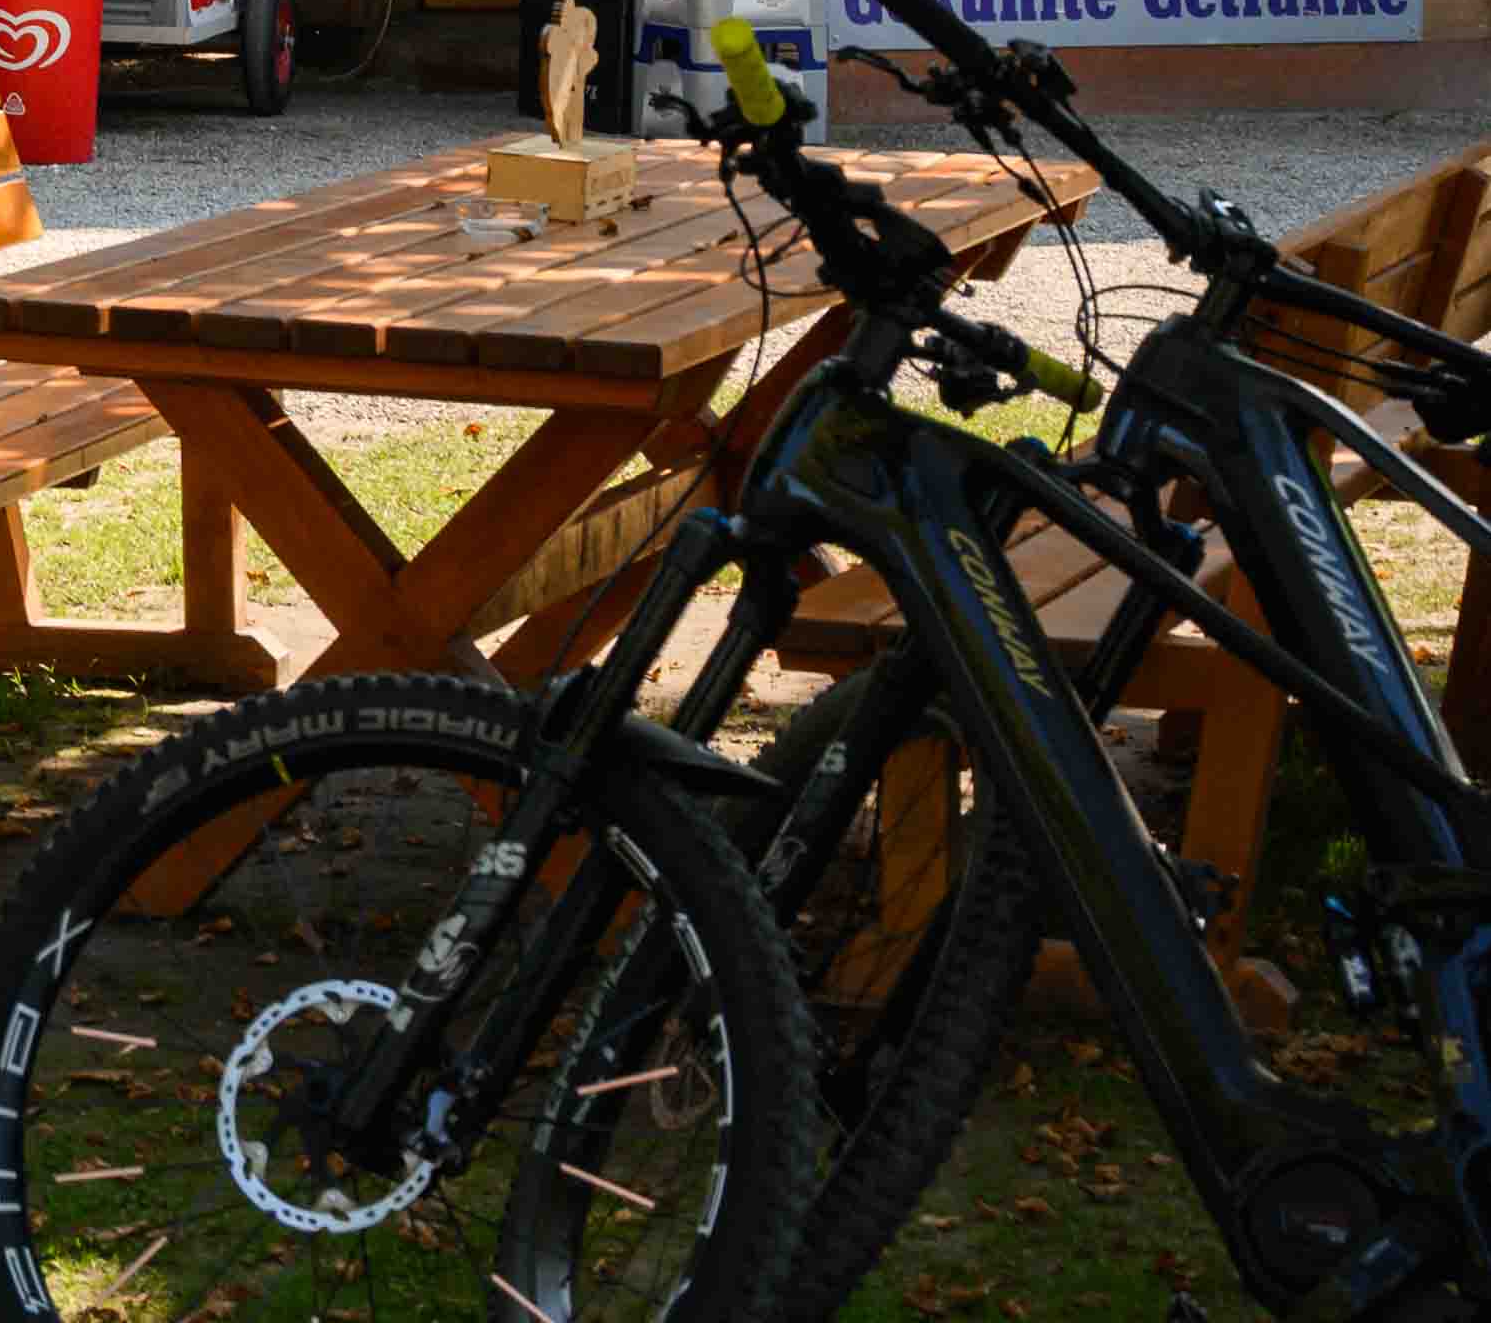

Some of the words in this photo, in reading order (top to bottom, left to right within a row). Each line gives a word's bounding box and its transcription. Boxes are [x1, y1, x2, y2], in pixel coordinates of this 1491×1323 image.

[949, 528, 1052, 698] CONWAY
[1274, 473, 1389, 674] CONWAY
[201, 710, 345, 775] MARY
[358, 706, 519, 751] MAGIC
